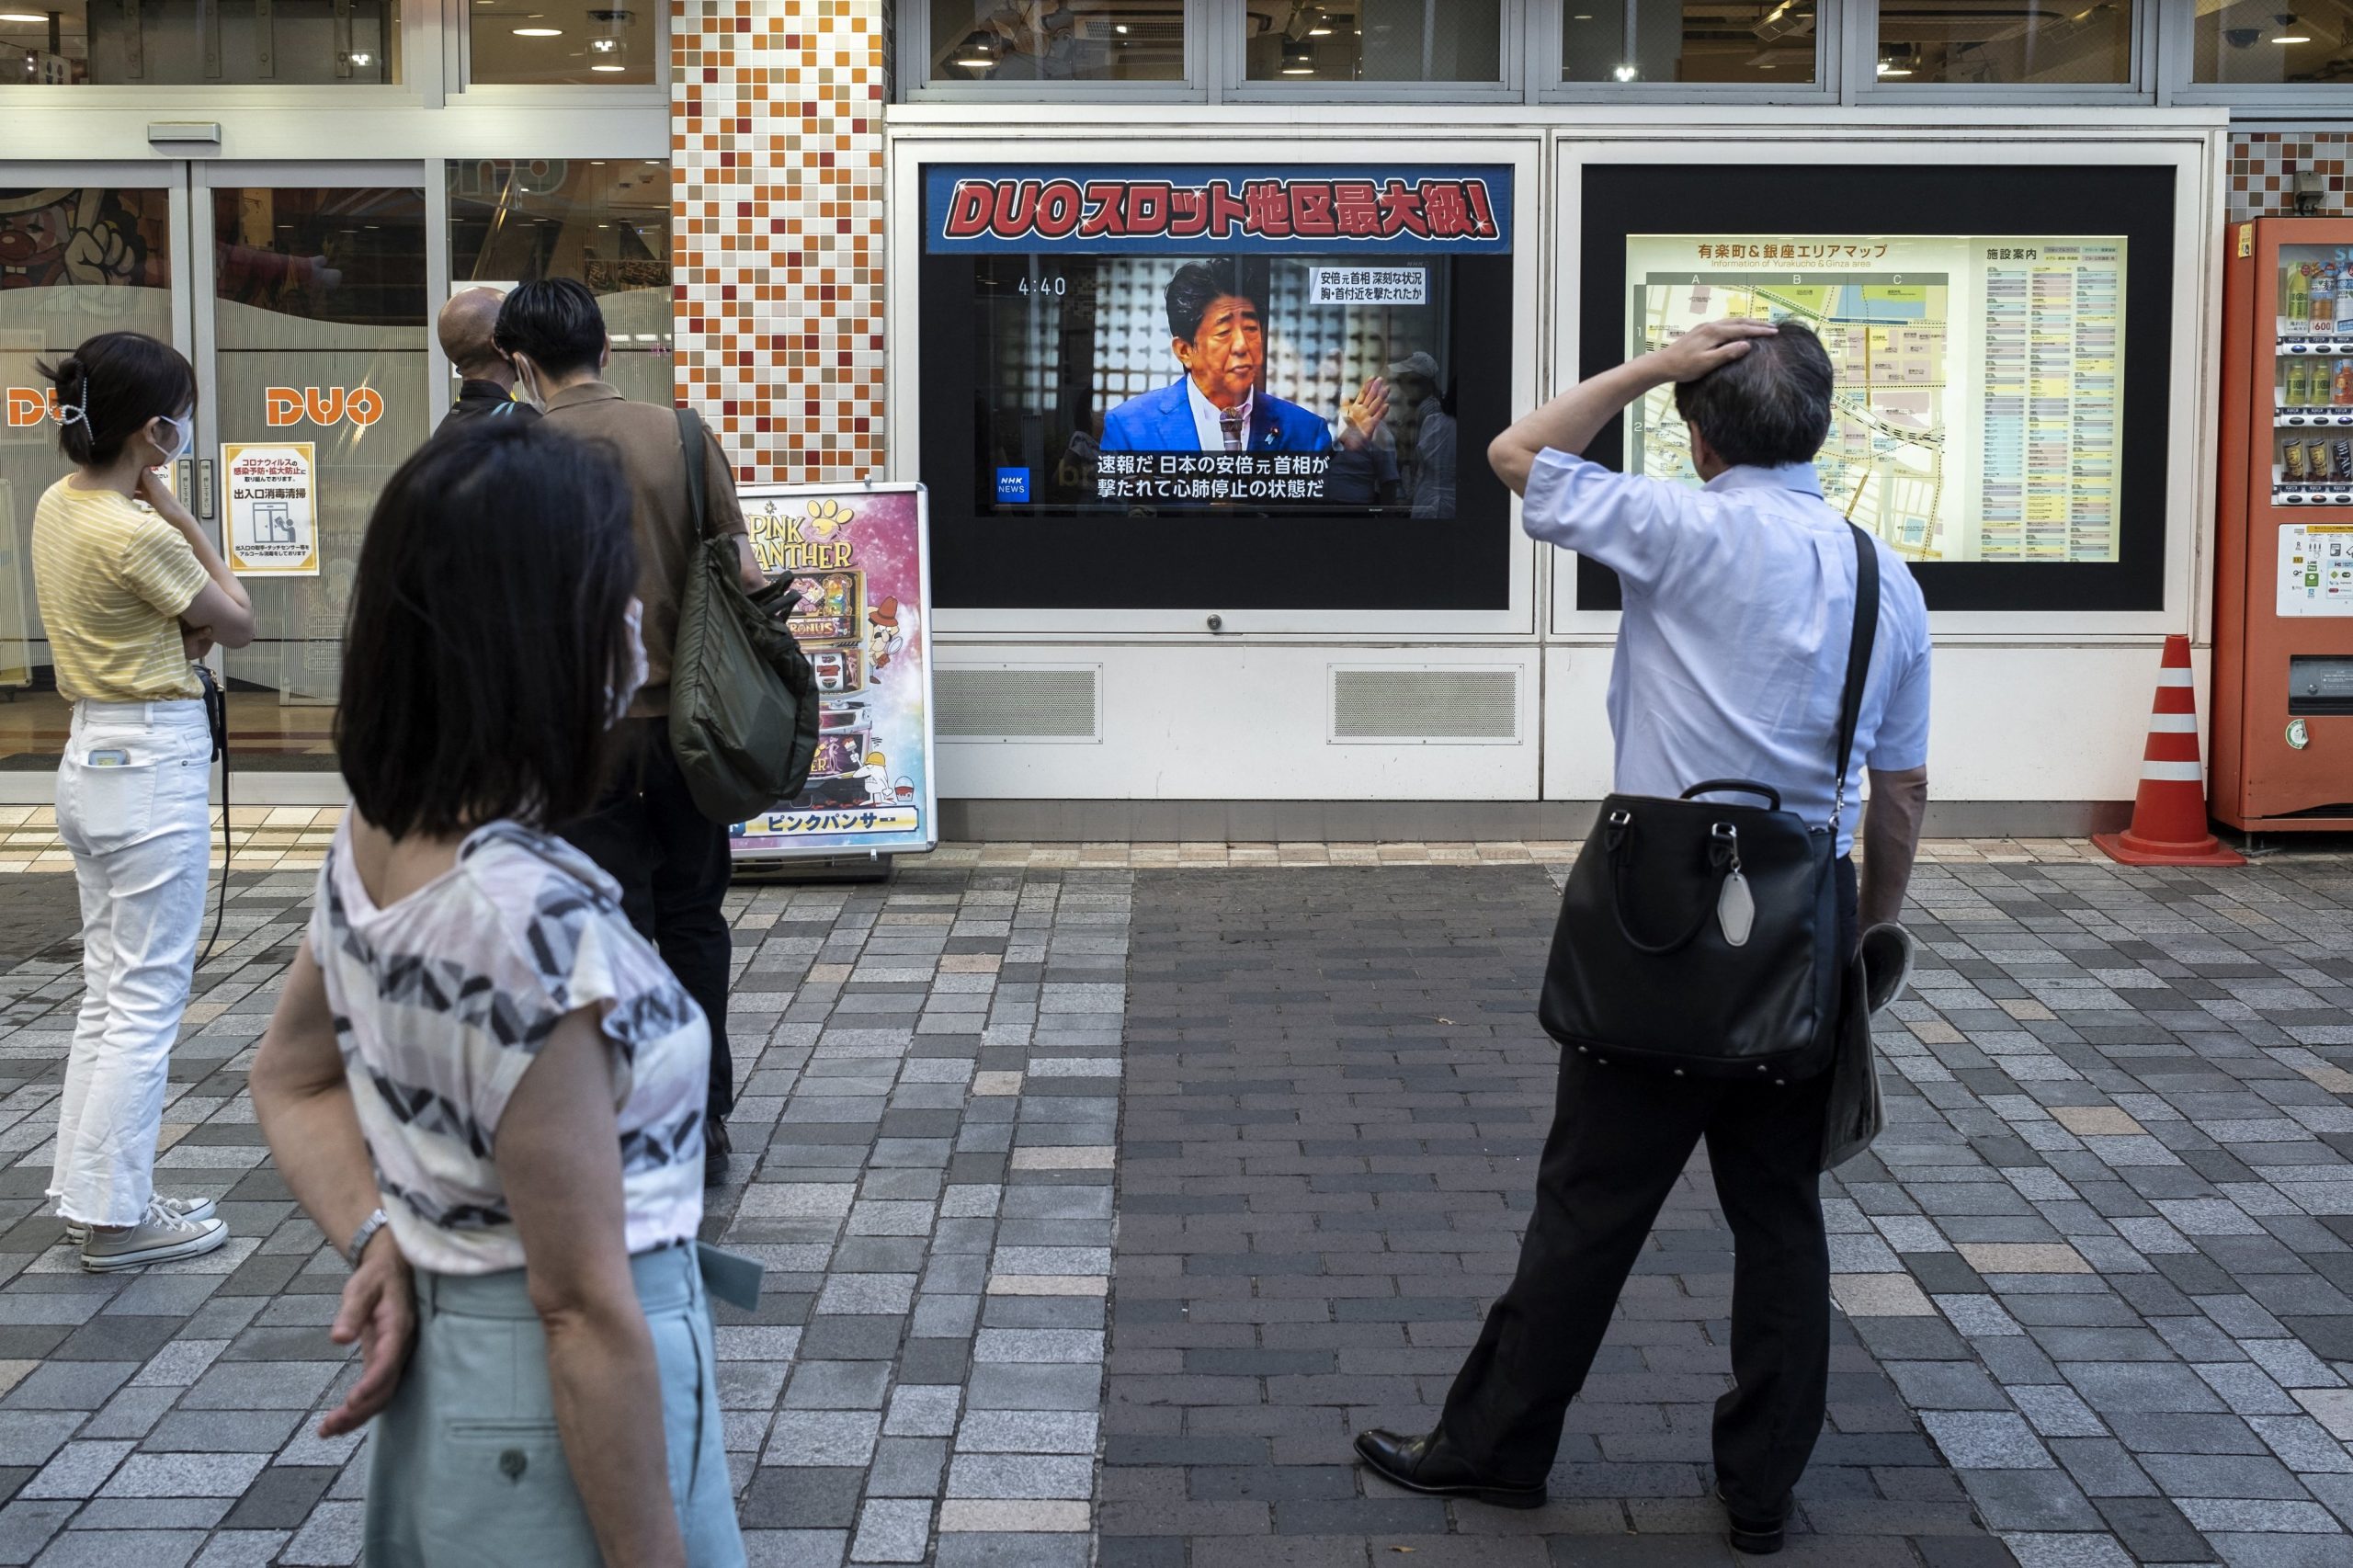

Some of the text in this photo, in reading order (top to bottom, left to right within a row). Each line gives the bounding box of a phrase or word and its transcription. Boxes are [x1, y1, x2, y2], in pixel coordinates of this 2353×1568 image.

[1986, 248, 2037, 260] 施設案内
[1773, 260, 1816, 268] Yurakucho
[1321, 271, 1422, 285] 安倍元首相 深刻な状況
[1691, 275, 1700, 284] A
[1792, 275, 1802, 284] B
[1893, 275, 1902, 284] C
[1018, 277, 1066, 296] 4:40
[266, 387, 383, 426] DUO
[1633, 422, 1643, 432] 2
[242, 459, 297, 467] コロナウィルスの
[1097, 455, 1330, 474] 速報だ 日本の安倍元首相が
[233, 466, 306, 475] 感染予防・拡大防止に
[233, 488, 306, 499] 出入口消毒清掃
[1097, 479, 1324, 499] 撃たれて心肺停止の状態だ
[749, 514, 806, 544] PINK
[767, 811, 897, 832] ピンクパンサー
